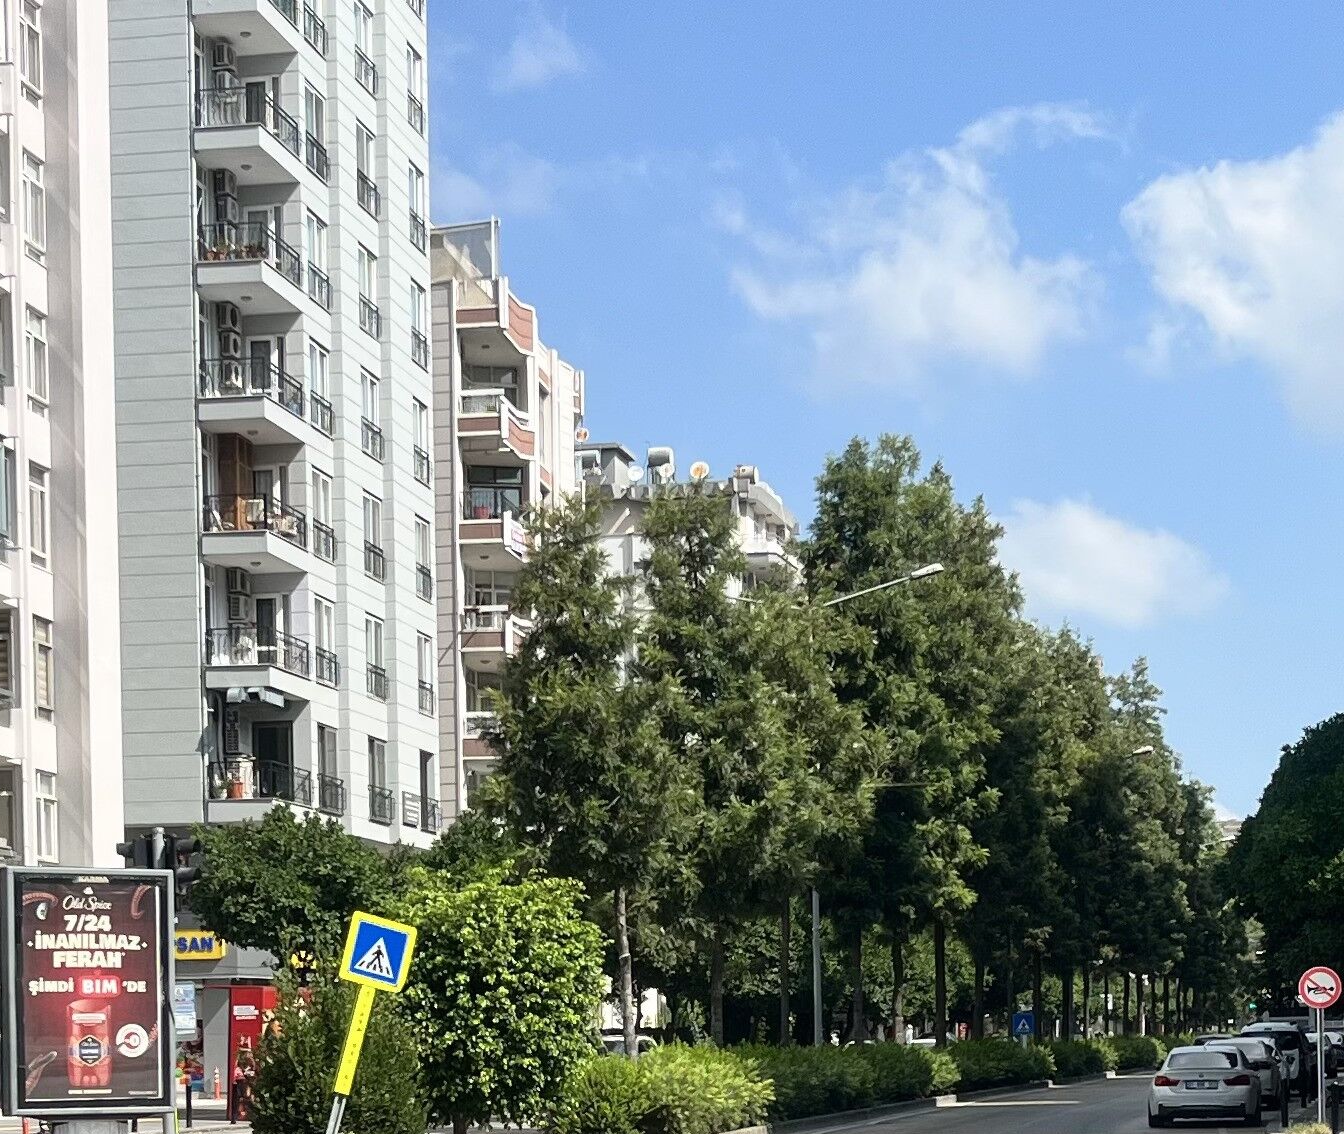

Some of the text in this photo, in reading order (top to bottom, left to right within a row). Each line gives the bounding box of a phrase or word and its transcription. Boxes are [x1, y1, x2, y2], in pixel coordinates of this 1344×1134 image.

[62, 895, 112, 912] Old Spice
[63, 914, 112, 932] 7/24
[34, 930, 142, 951] İNANILMAZ
[28, 977, 75, 996] ŞİMDİ
